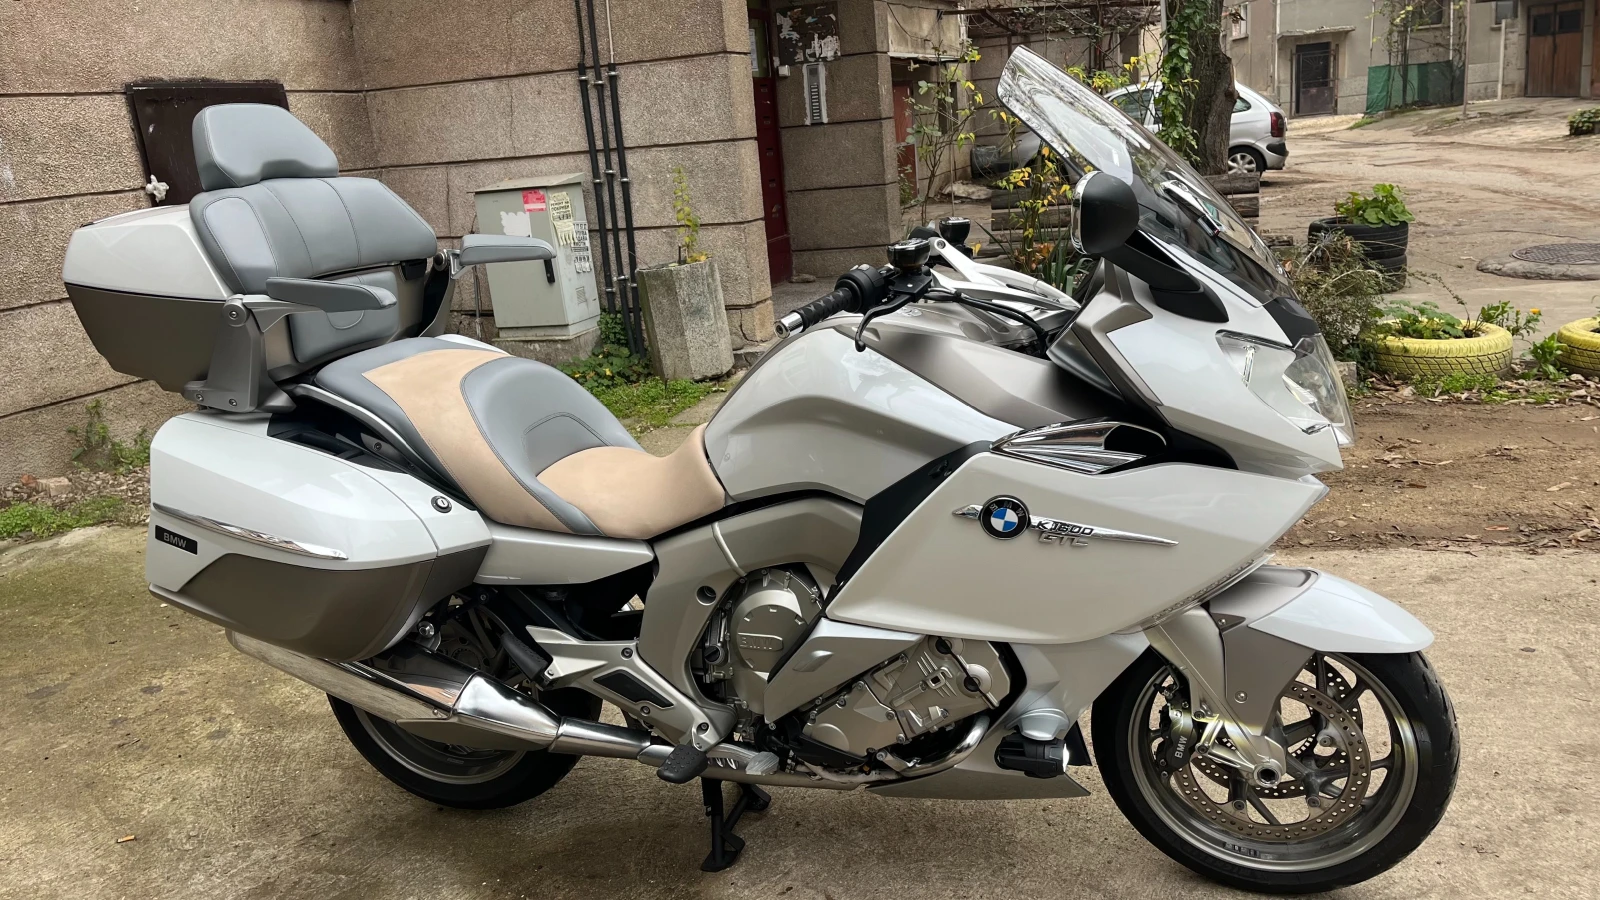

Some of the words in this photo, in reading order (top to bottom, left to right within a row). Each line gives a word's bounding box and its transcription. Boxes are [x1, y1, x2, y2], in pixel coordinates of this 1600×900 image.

[989, 501, 1026, 518] BMW
[163, 532, 187, 548] BMW
[1038, 532, 1089, 547] GTL
[739, 637, 773, 650] BMW
[1174, 735, 1188, 759] BMW
